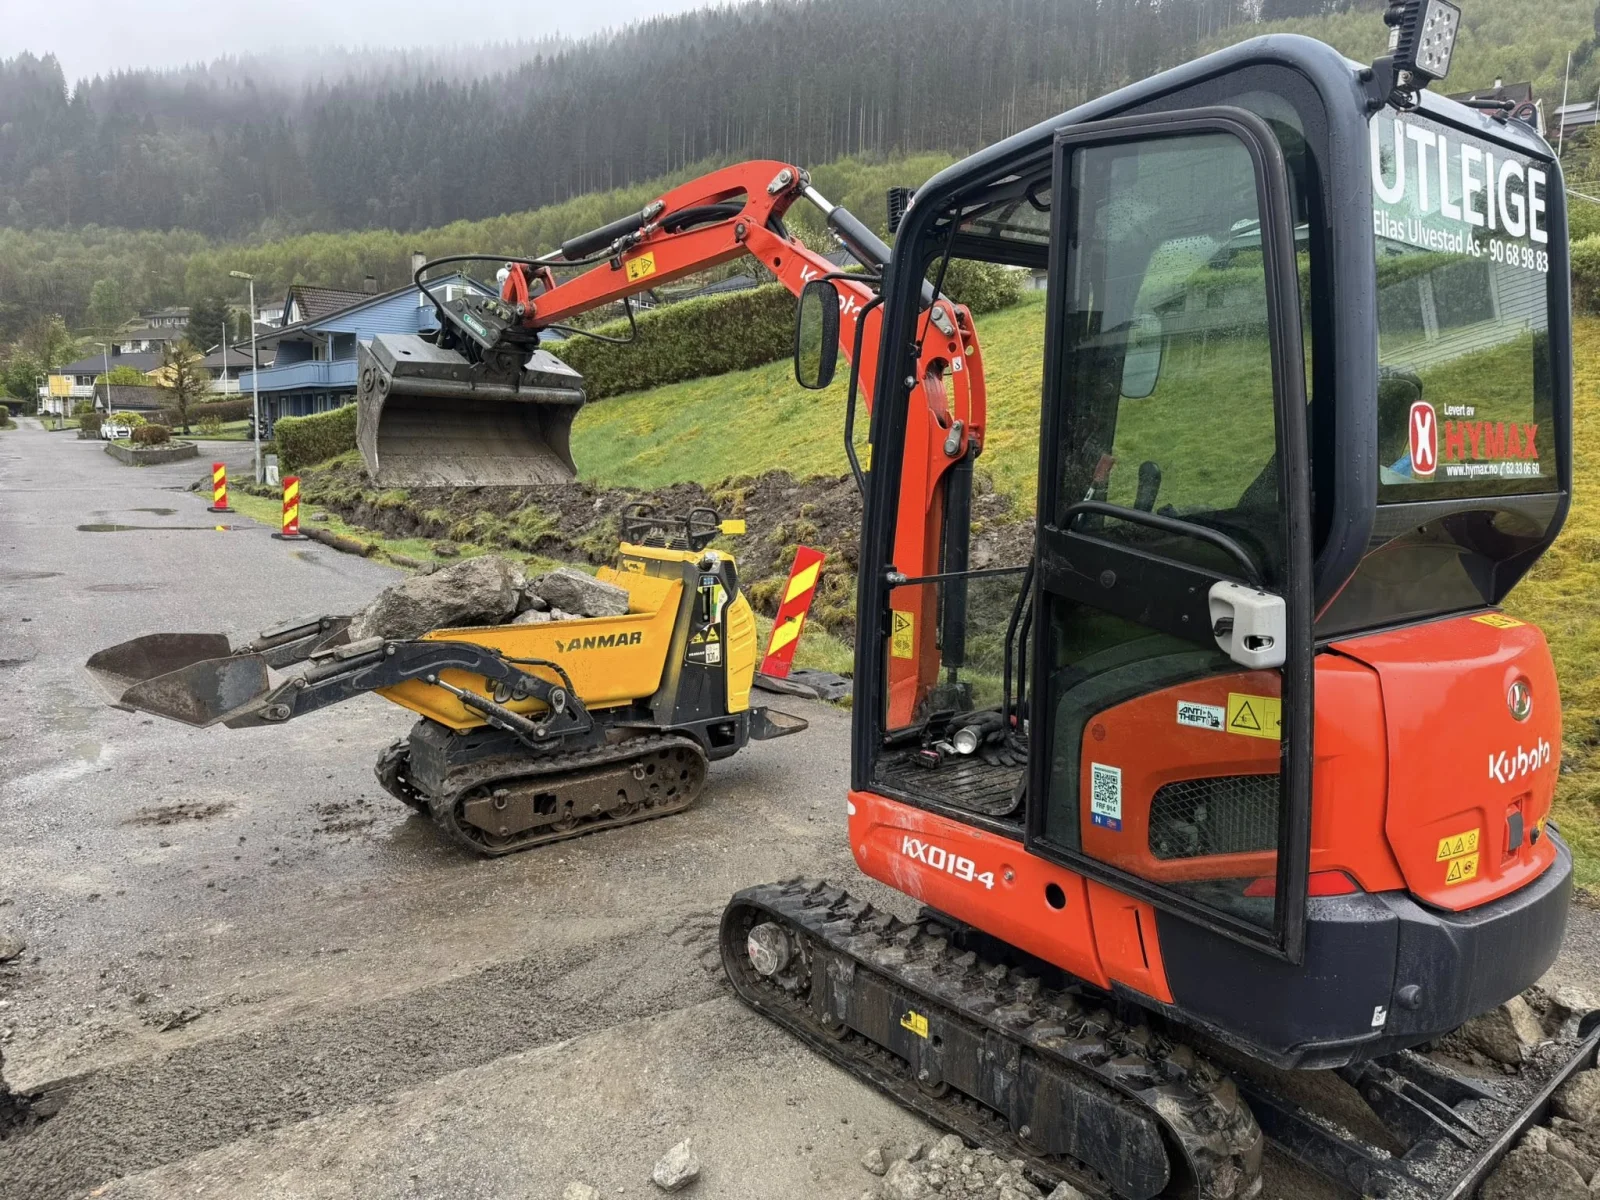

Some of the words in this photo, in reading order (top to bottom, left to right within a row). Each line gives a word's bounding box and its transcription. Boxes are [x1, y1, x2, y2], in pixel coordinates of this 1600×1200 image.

[1369, 111, 1549, 244] UTLEIGE
[1373, 209, 1405, 240] Elias
[1407, 217, 1463, 254] Ulvestad
[1466, 232, 1480, 257] As
[1489, 238, 1504, 263] 90
[1505, 242, 1520, 266] 68
[1521, 246, 1535, 270] 98
[1536, 250, 1549, 273] 83
[1443, 403, 1465, 416] Levert
[1466, 406, 1475, 416] av
[1445, 420, 1539, 460] HYMAX
[1446, 463, 1498, 479] www.hymax.no
[1506, 462, 1514, 474] 62
[1515, 462, 1523, 474] 33
[1524, 463, 1532, 474] 06
[1532, 463, 1540, 474] 60
[555, 631, 642, 653] YANMAR
[1178, 712, 1207, 723] THEFT
[1488, 736, 1551, 784] Kubota
[1095, 814, 1101, 824] N
[901, 835, 996, 890] KX019-4
